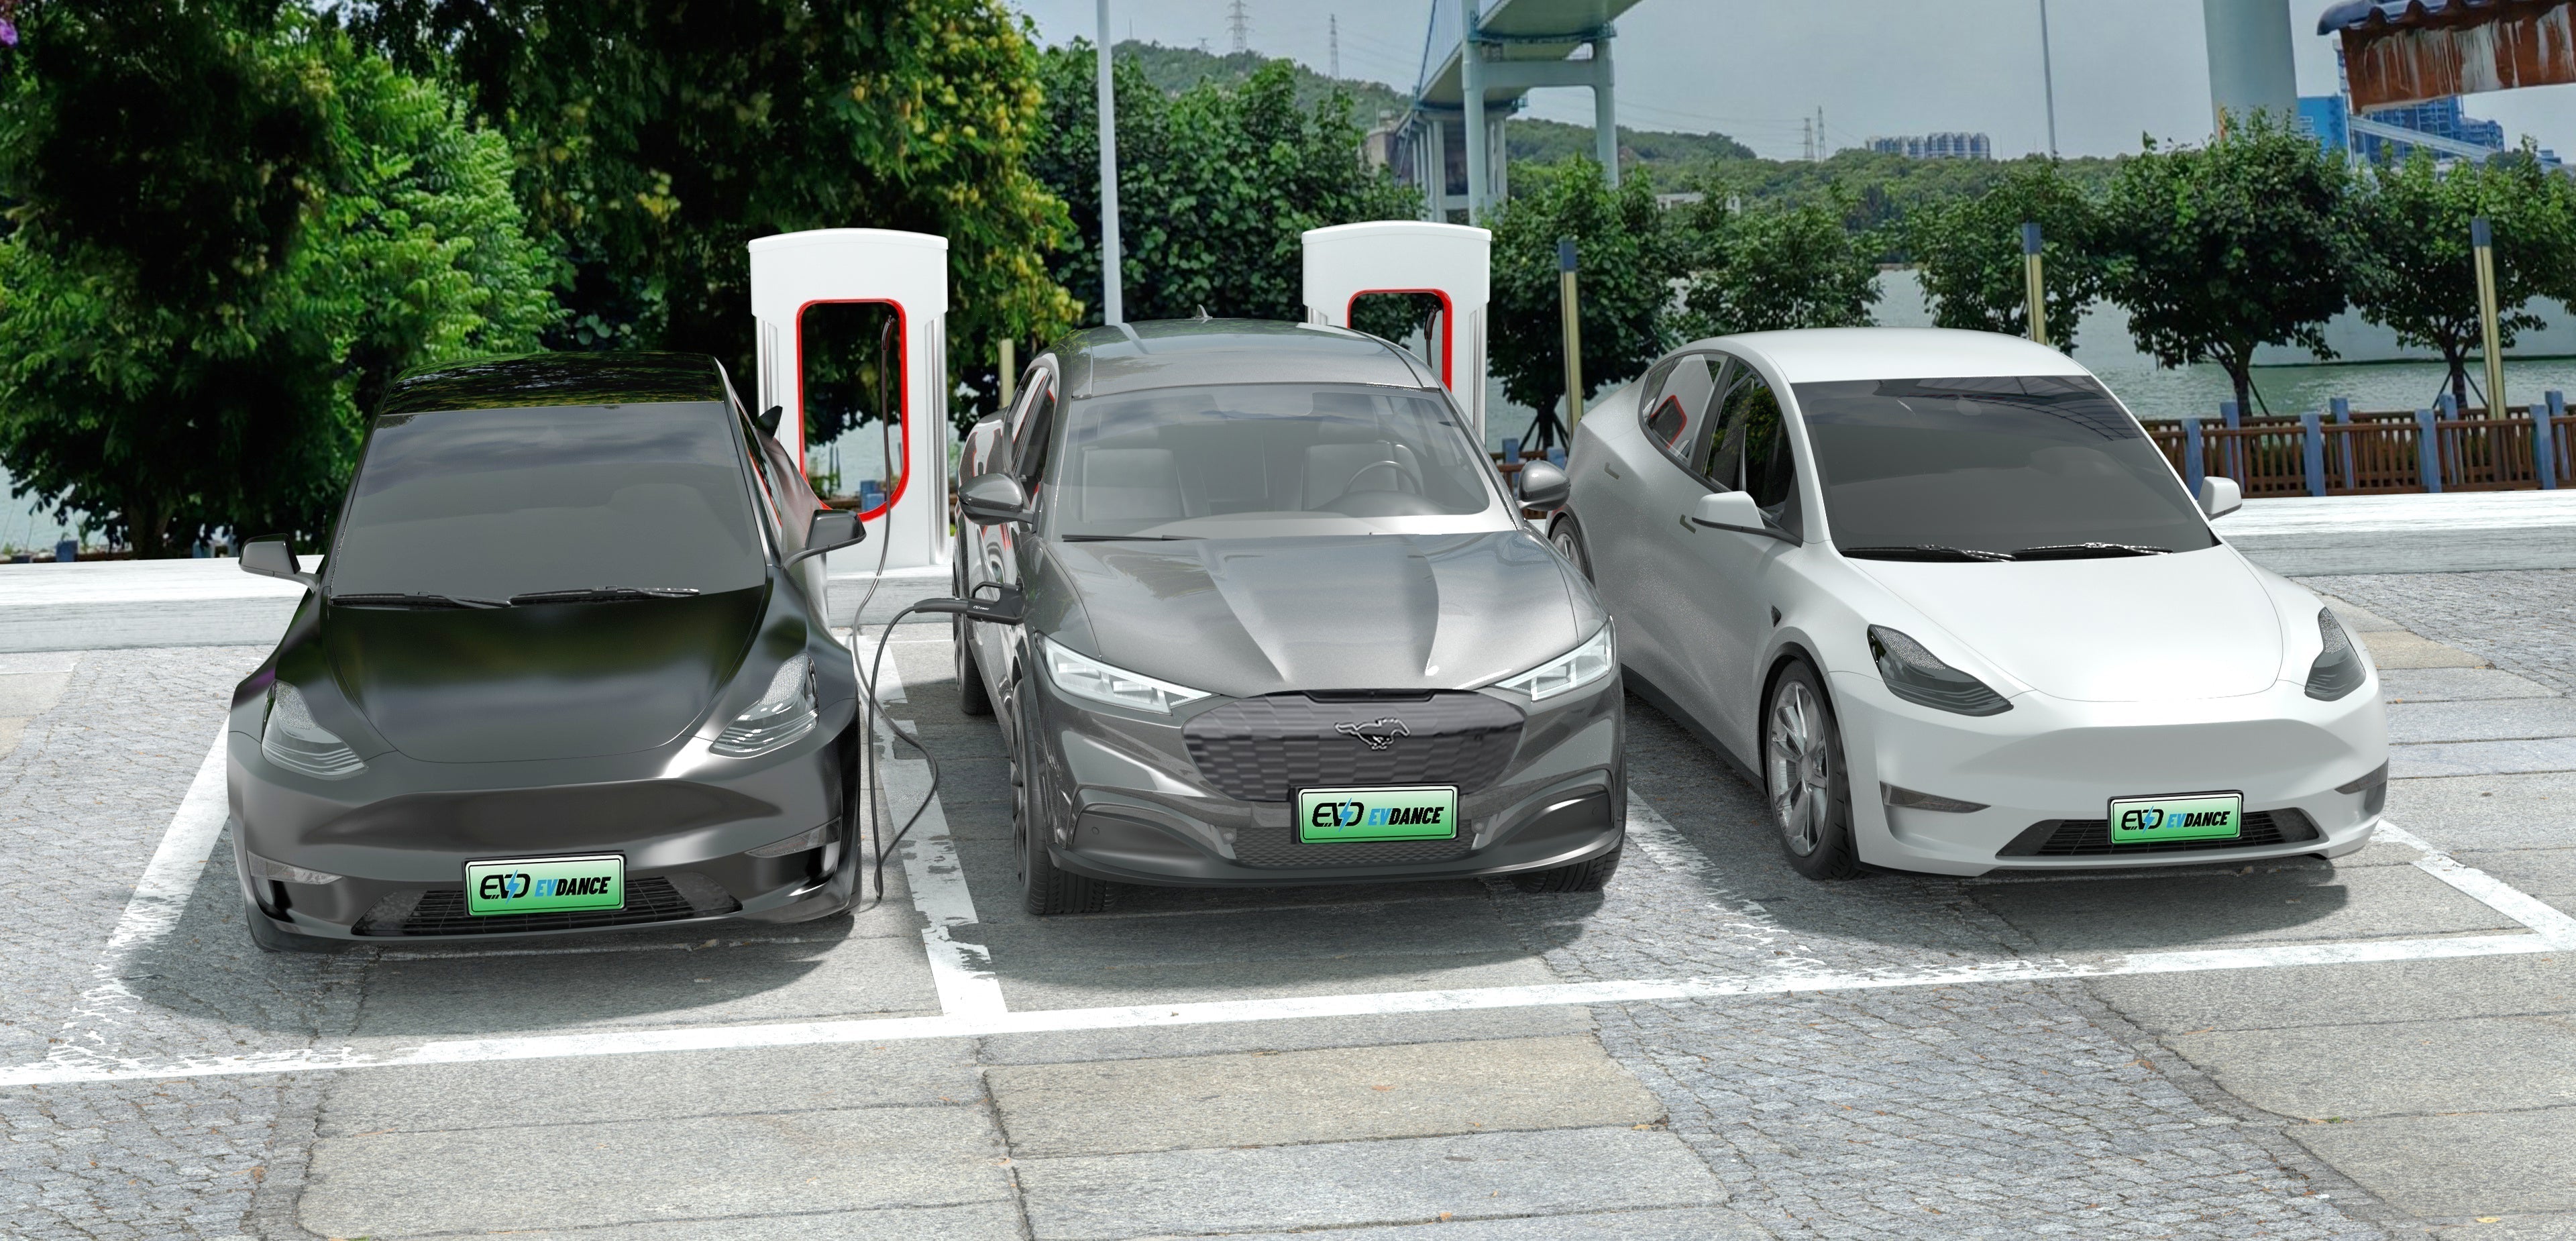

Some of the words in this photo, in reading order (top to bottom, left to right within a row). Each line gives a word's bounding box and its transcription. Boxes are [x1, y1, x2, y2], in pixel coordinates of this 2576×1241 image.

[1367, 807, 1444, 826] EVDANCE
[2166, 811, 2231, 828] EVDANCE
[535, 877, 611, 897] EVDANCE
